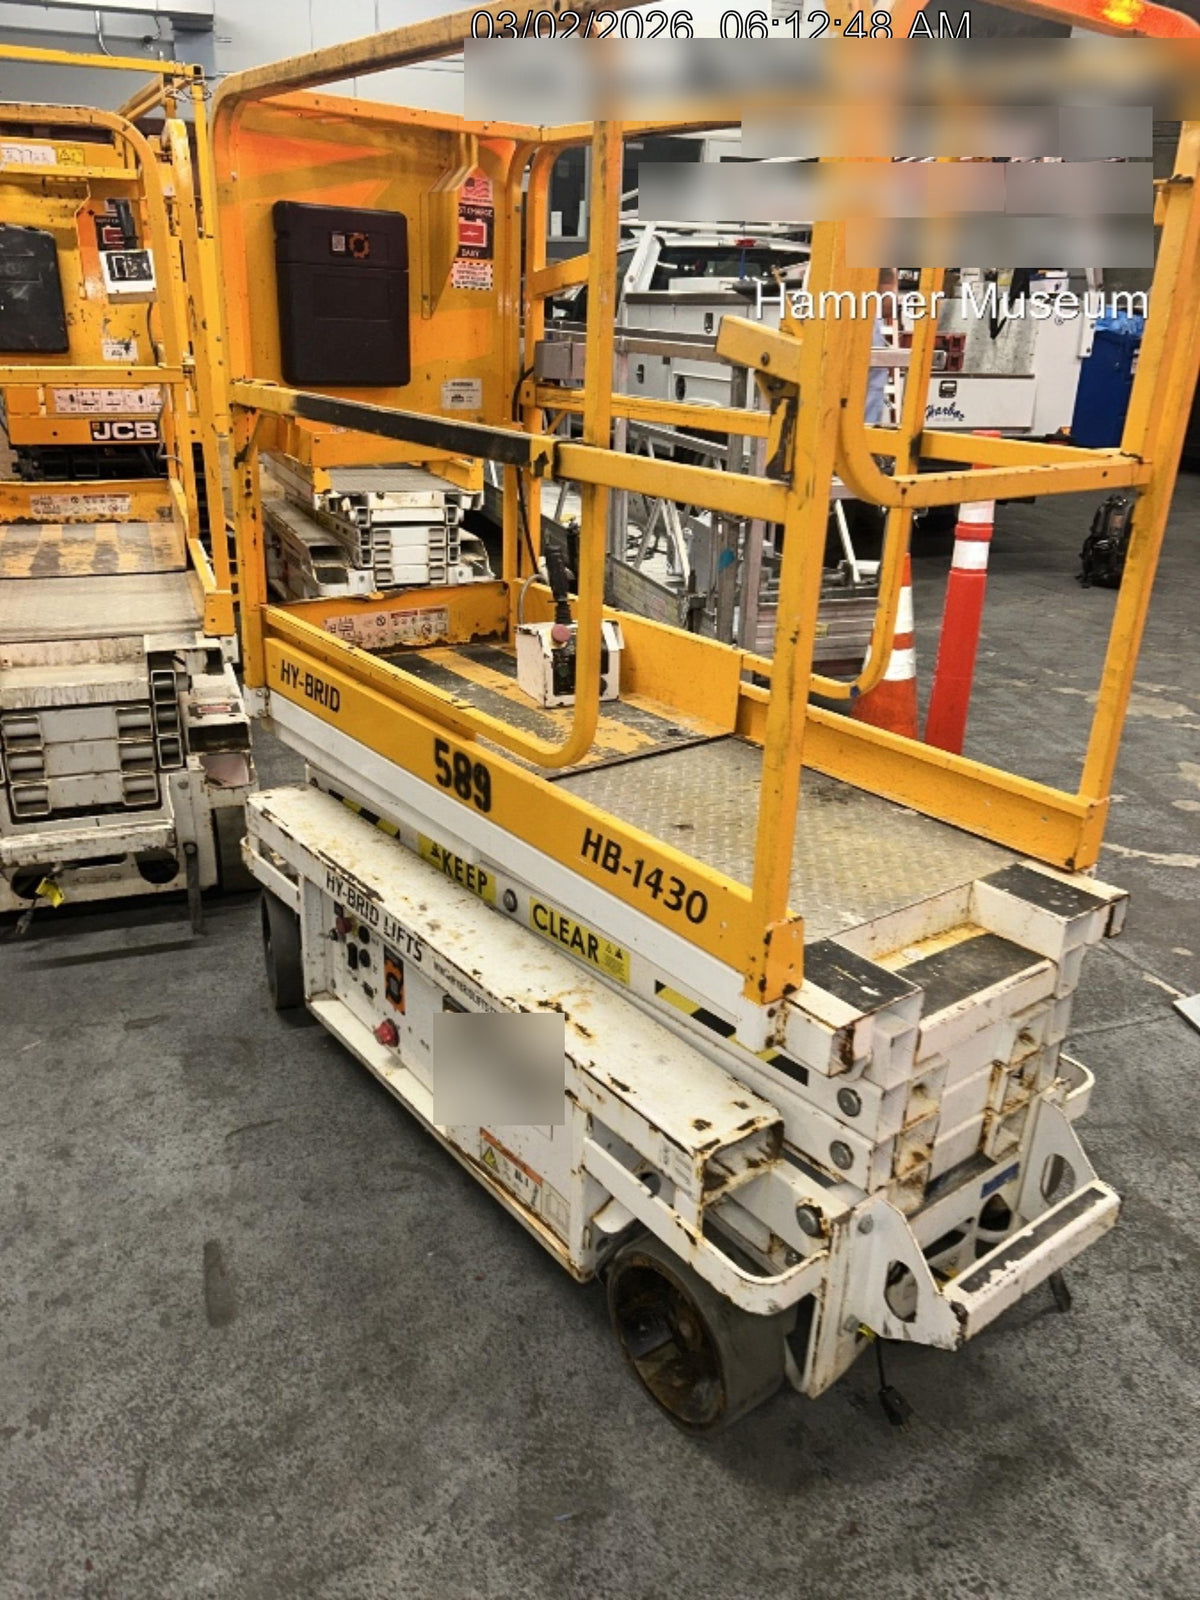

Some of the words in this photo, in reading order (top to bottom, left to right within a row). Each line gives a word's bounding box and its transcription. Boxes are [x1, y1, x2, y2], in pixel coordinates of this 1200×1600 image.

[92, 422, 159, 440] JCB
[281, 659, 341, 713] HY-BRID
[434, 738, 492, 813] 589
[326, 871, 380, 927] HY-BRID
[384, 917, 424, 962] LIFTS
[441, 851, 488, 894] KEEP
[532, 904, 600, 963] CLEAR
[581, 827, 709, 925] HB-1430
